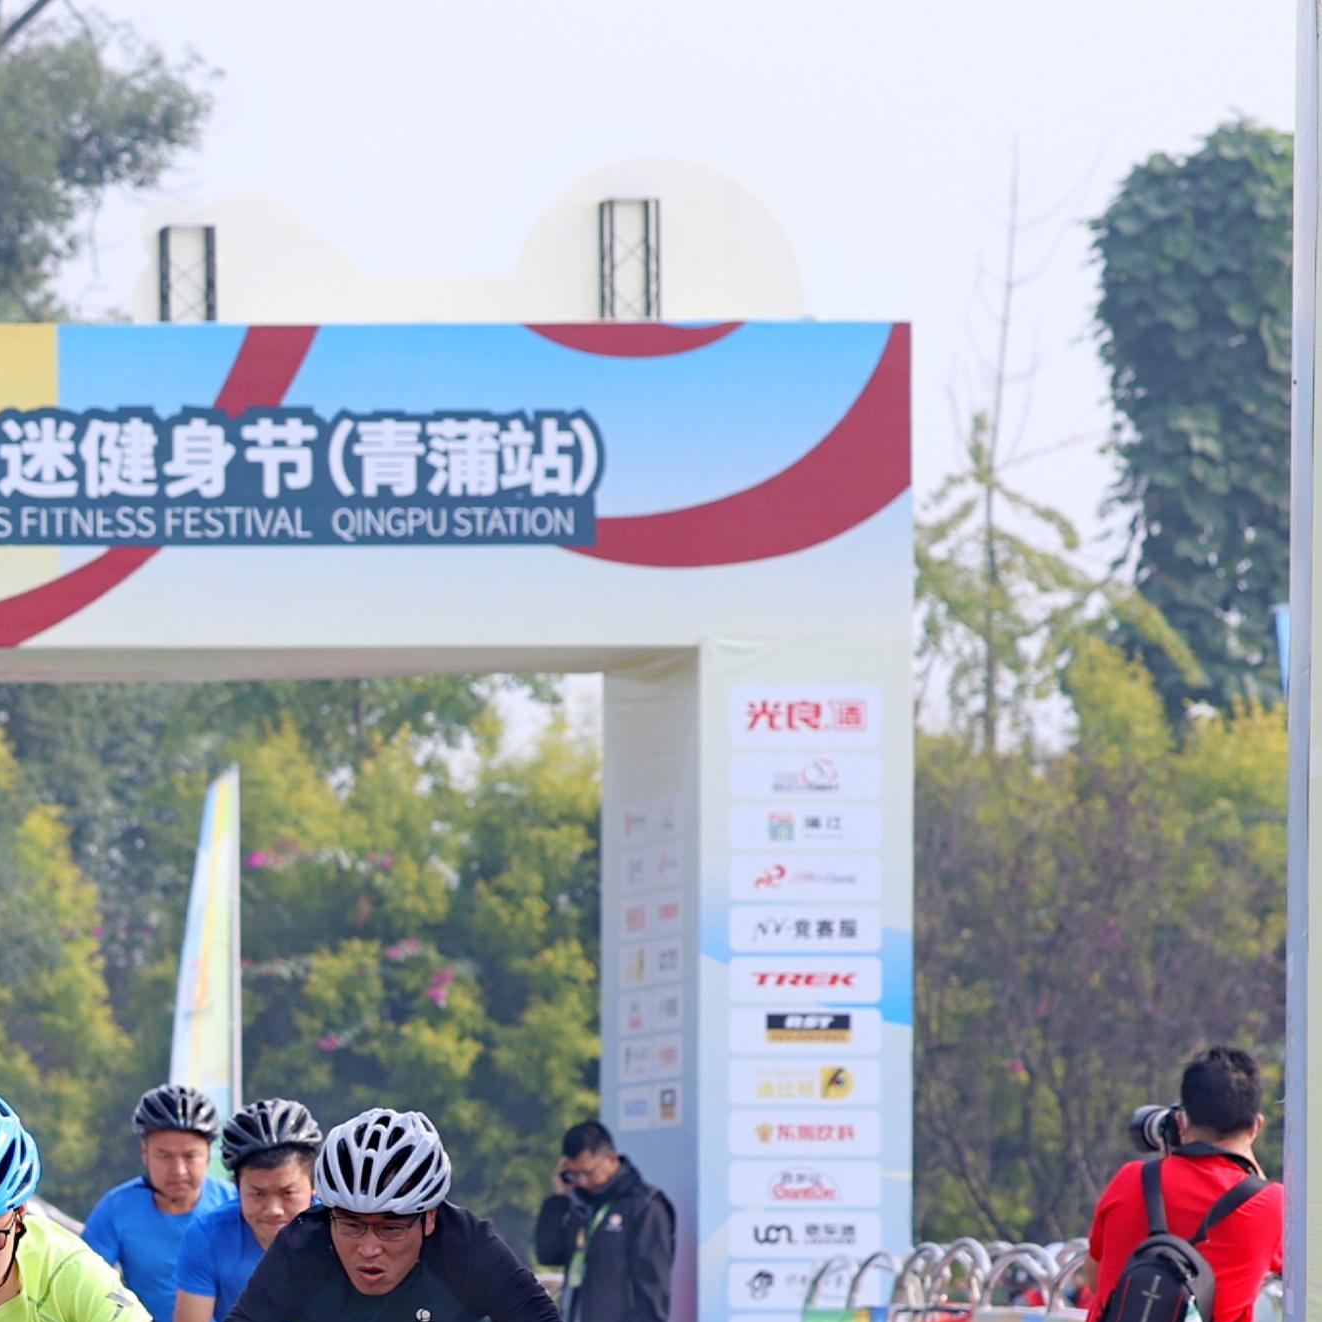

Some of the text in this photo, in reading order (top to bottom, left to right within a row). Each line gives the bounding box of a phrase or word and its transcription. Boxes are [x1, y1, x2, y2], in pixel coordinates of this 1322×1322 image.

[20, 506, 156, 540] FITNESS
[164, 506, 313, 539] FESTIVAL
[332, 506, 575, 542] QINGPU STATION
[753, 972, 856, 987] TREK
